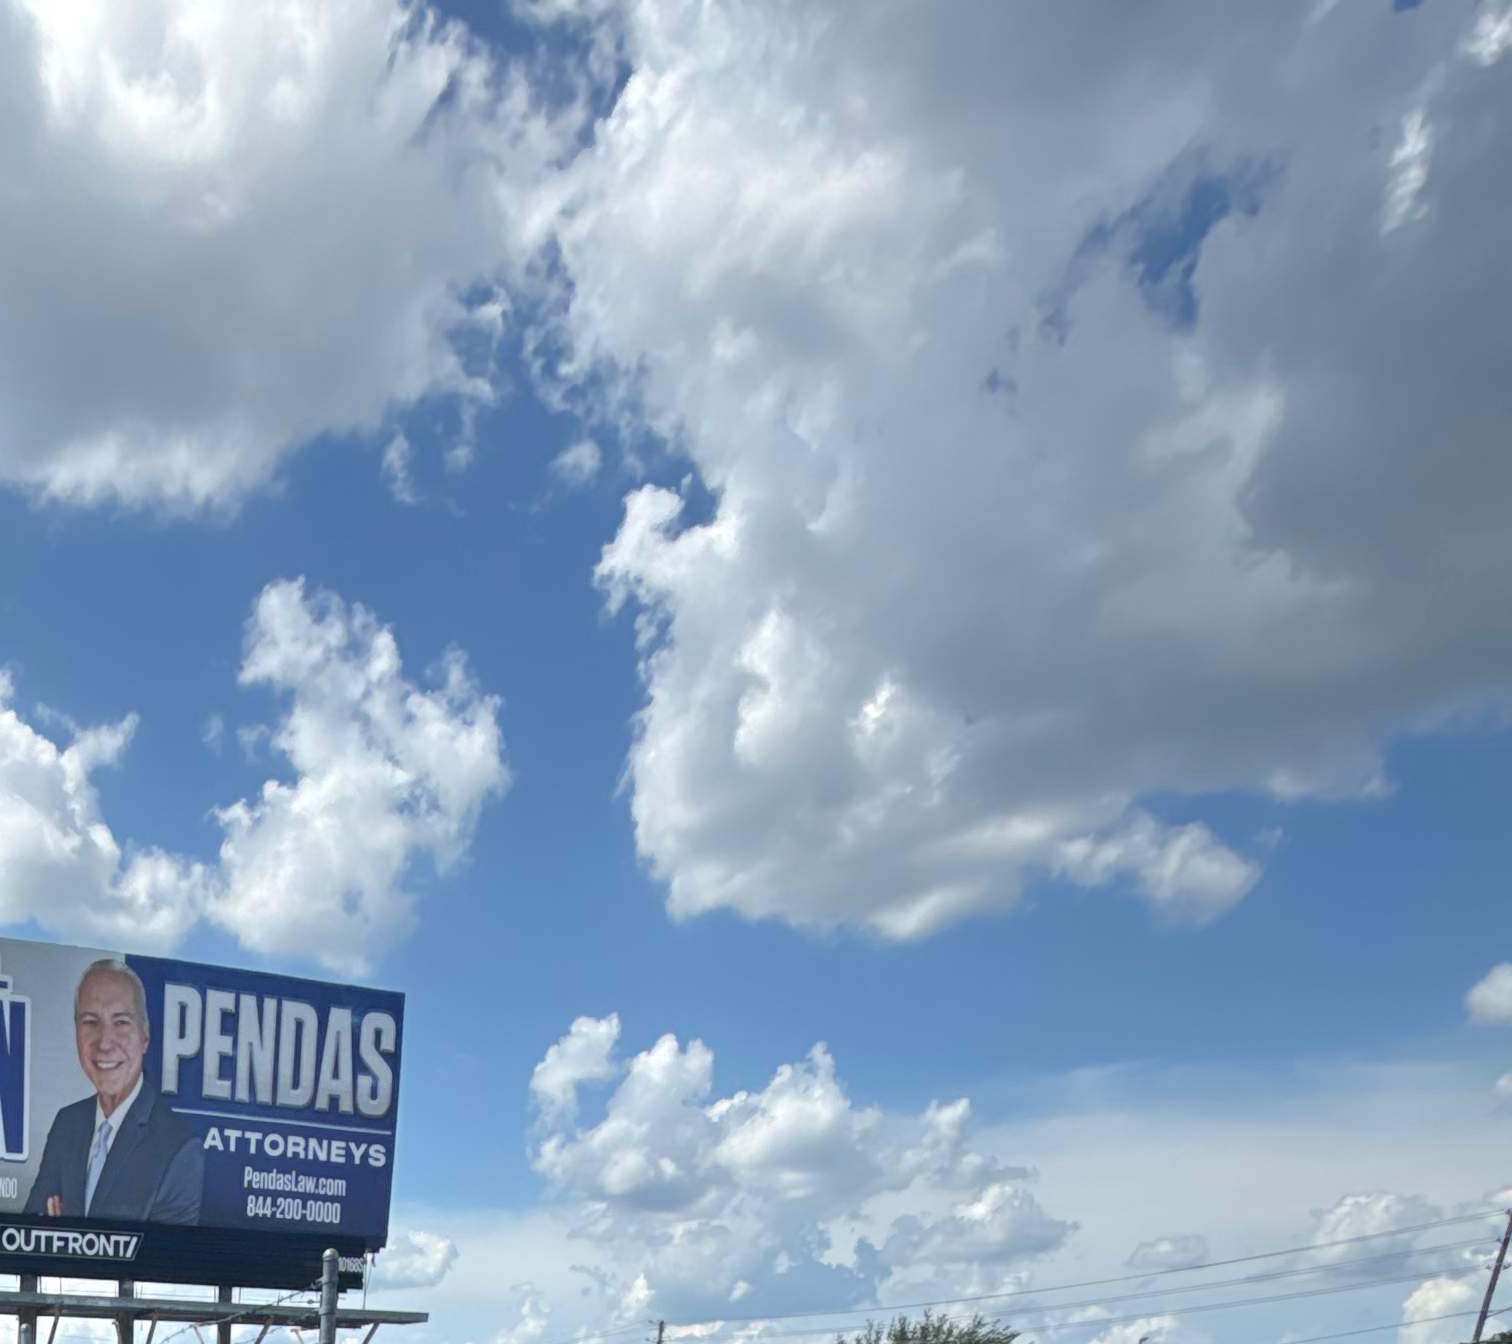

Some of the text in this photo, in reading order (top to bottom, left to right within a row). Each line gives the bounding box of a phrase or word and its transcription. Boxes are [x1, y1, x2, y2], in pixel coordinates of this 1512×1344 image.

[160, 982, 397, 1119] PENDAS
[202, 1126, 387, 1168] ATTORNEYS
[243, 1166, 347, 1197] PendasLaw.com
[246, 1195, 341, 1224] 844-200-0000
